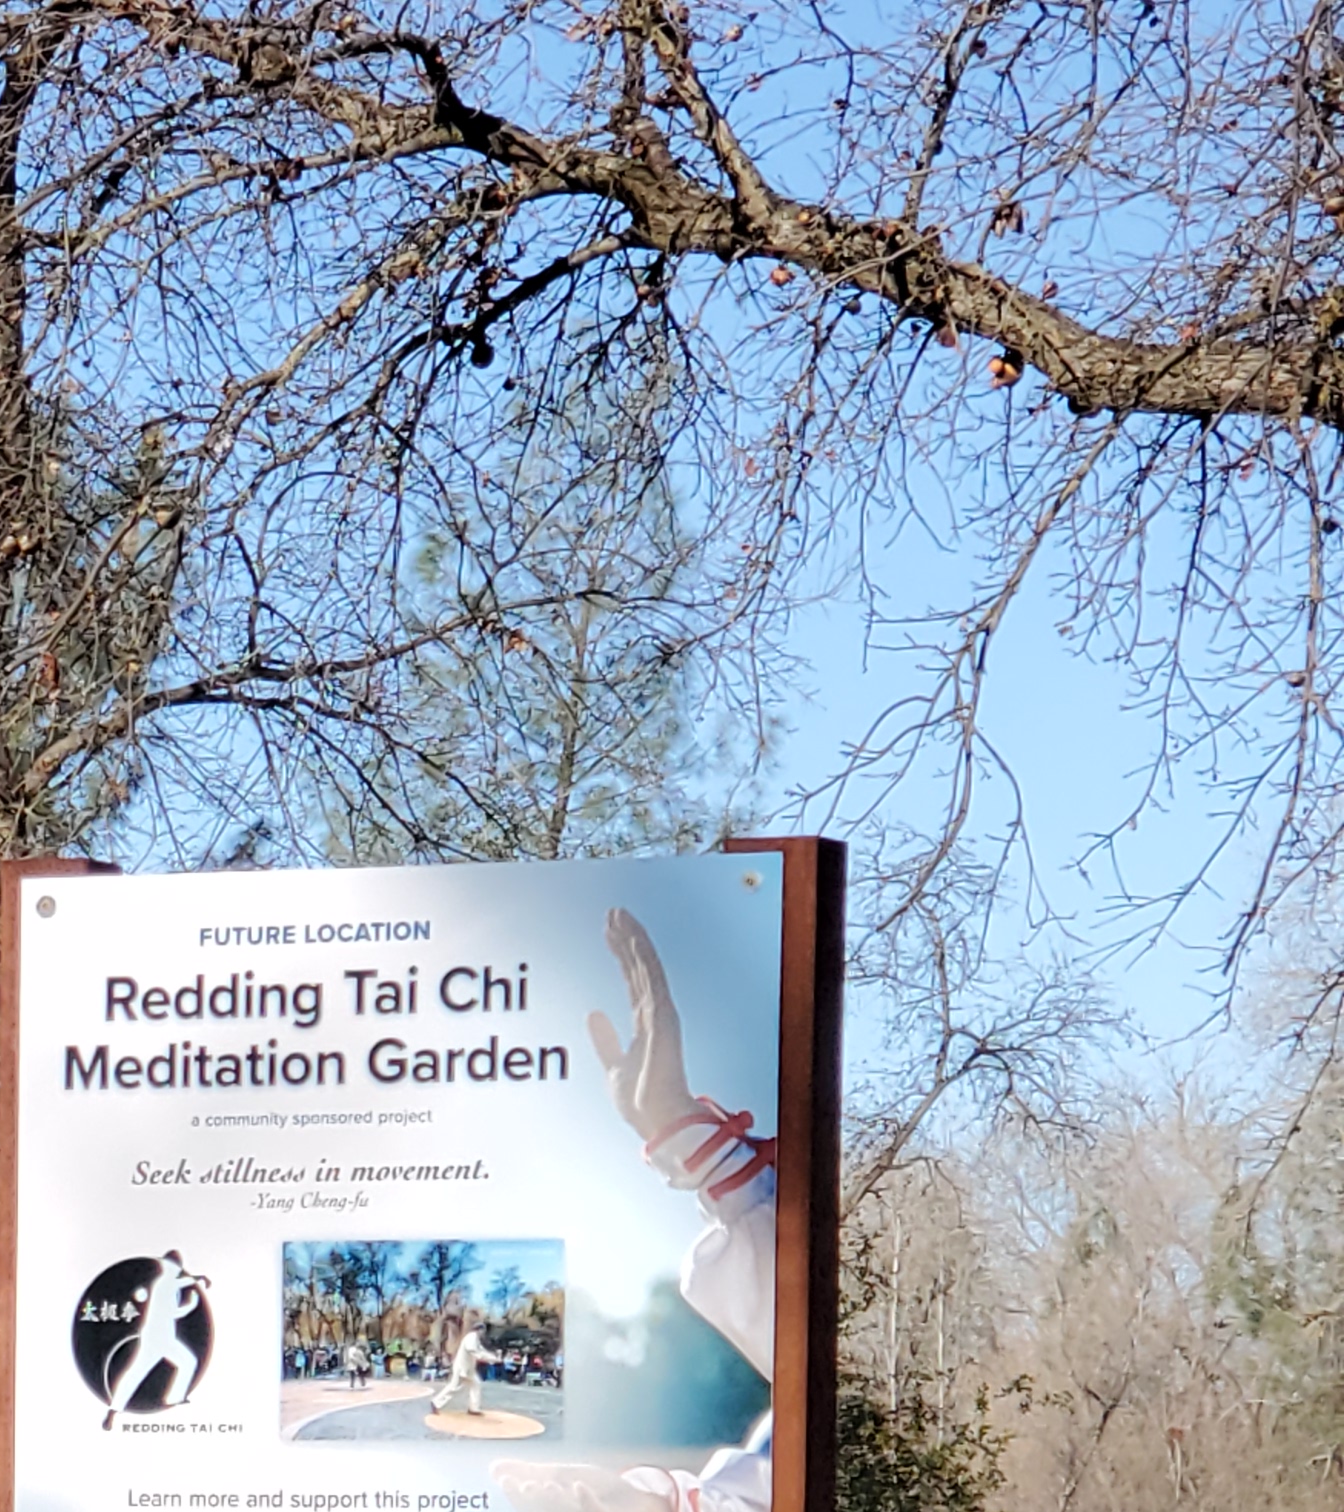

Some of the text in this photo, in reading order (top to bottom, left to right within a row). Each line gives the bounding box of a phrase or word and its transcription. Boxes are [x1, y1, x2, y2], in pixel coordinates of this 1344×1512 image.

[199, 920, 431, 947] FUTURE LOCATION
[105, 962, 529, 1028] Redding Tai Chi
[63, 1035, 570, 1091] Meditation Garden
[191, 1109, 433, 1129] a community sponsored project
[131, 1157, 490, 1186] Seek stillness in movement.
[122, 1424, 243, 1433] REDDING TAI CHI
[128, 1489, 490, 1512] Learn more and support this project
